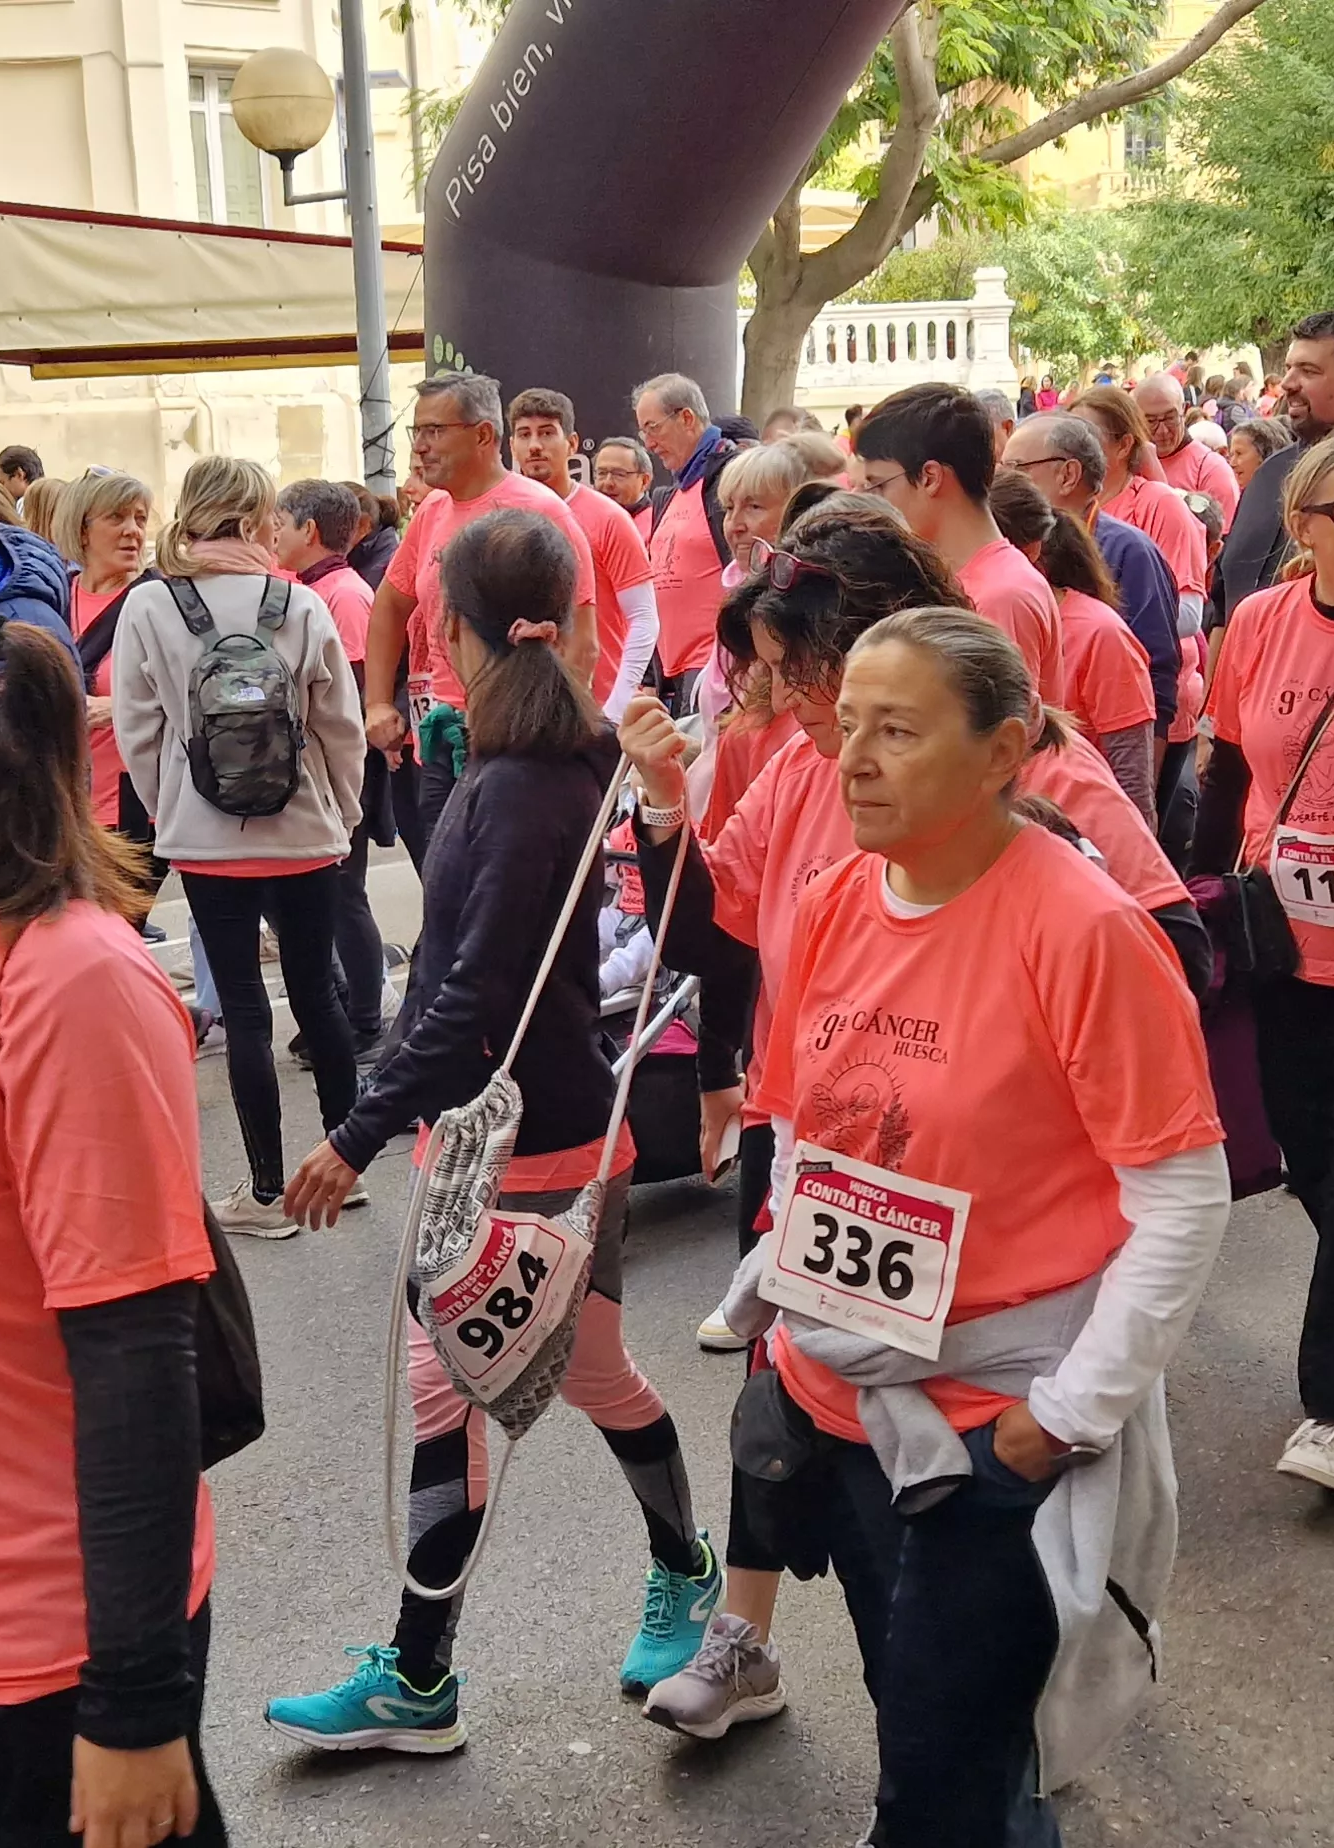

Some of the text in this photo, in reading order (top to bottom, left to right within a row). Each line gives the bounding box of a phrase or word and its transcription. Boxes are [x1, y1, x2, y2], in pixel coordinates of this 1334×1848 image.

[445, 133, 497, 219] Pisa
[490, 42, 554, 133] bien,
[1278, 690, 1303, 715] 9ª
[1282, 848, 1319, 863] CONTRA
[1320, 855, 1333, 863] EL
[815, 1013, 848, 1050] 9ª
[851, 1007, 940, 1043] CÁNCER
[893, 1041, 948, 1065] HUESCA
[803, 1179, 941, 1238] CONTRA EL CÁNCER
[849, 1179, 888, 1203] HUESCA
[438, 1226, 516, 1325] ONTRA EL CÁNCE
[803, 1212, 914, 1301] 336
[451, 1263, 488, 1297] HUESCA
[456, 1250, 549, 1360] 984
